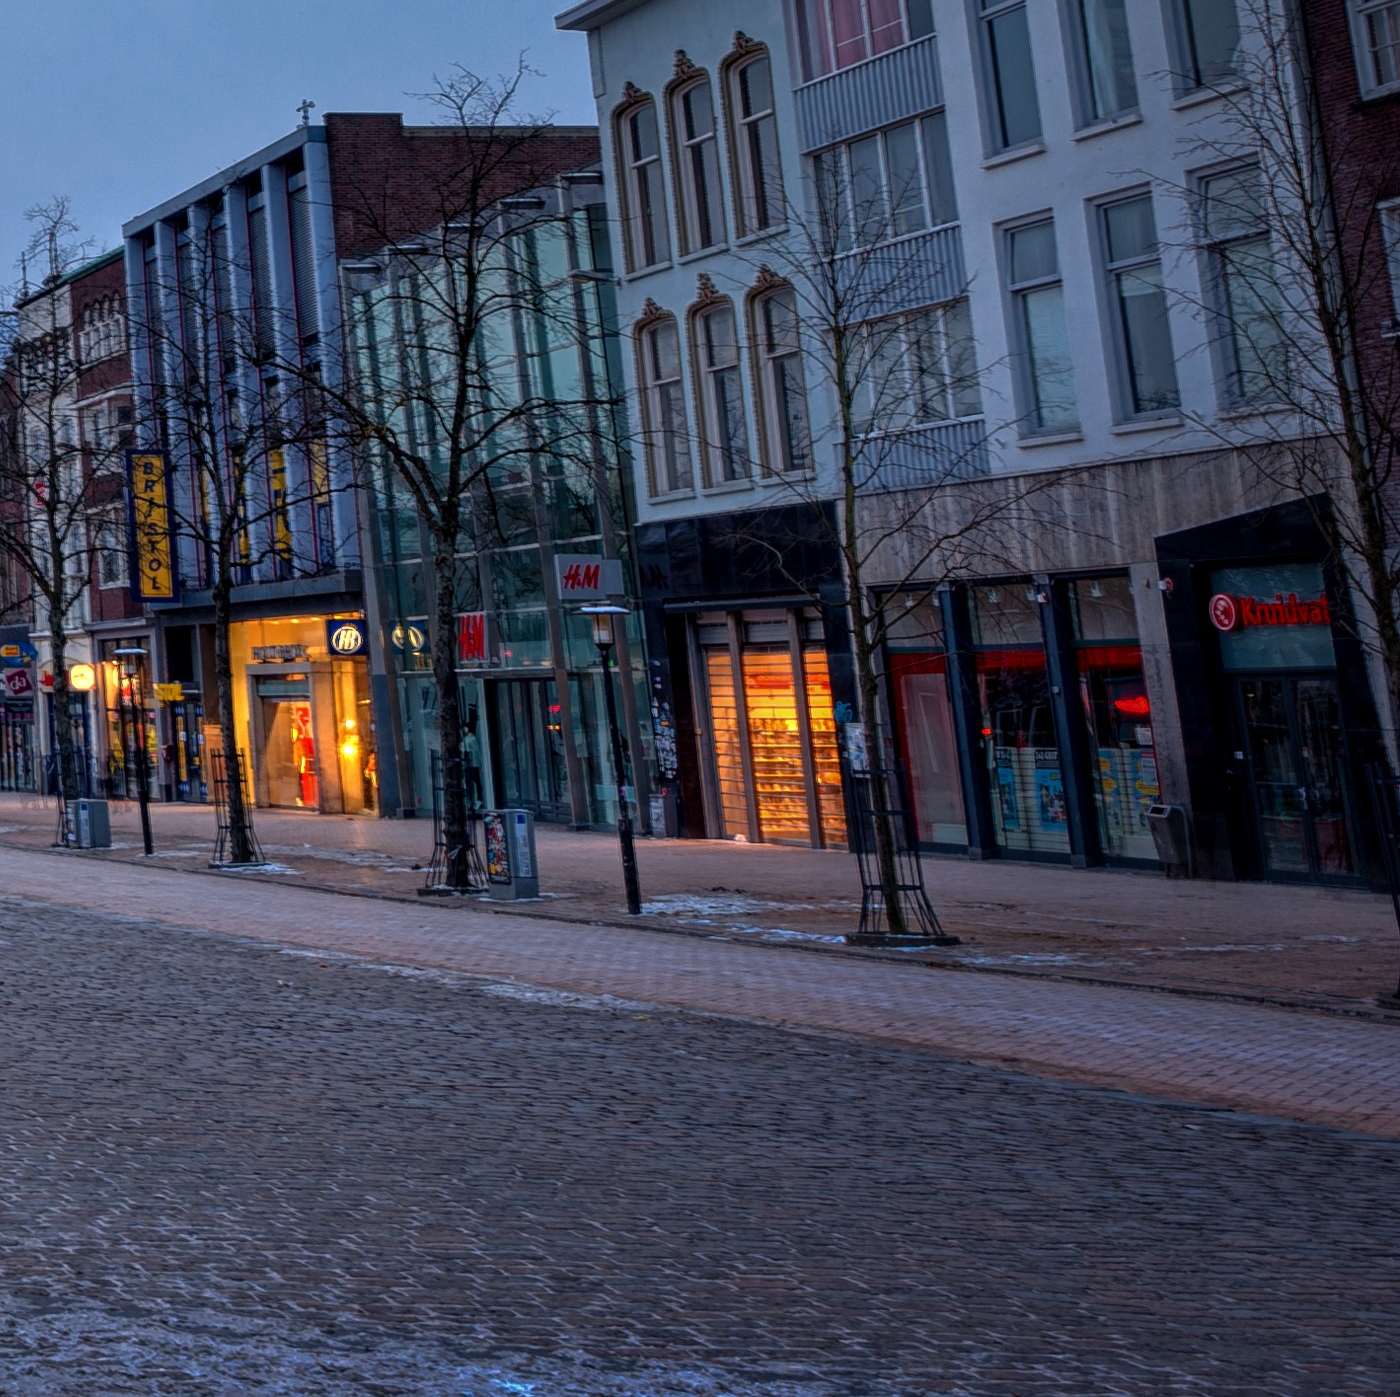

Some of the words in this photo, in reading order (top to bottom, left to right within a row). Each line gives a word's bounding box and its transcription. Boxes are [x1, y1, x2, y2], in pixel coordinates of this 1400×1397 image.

[143, 462, 161, 589] BRISTOL
[563, 564, 599, 590] H&M
[1239, 593, 1329, 626] Kruidvat
